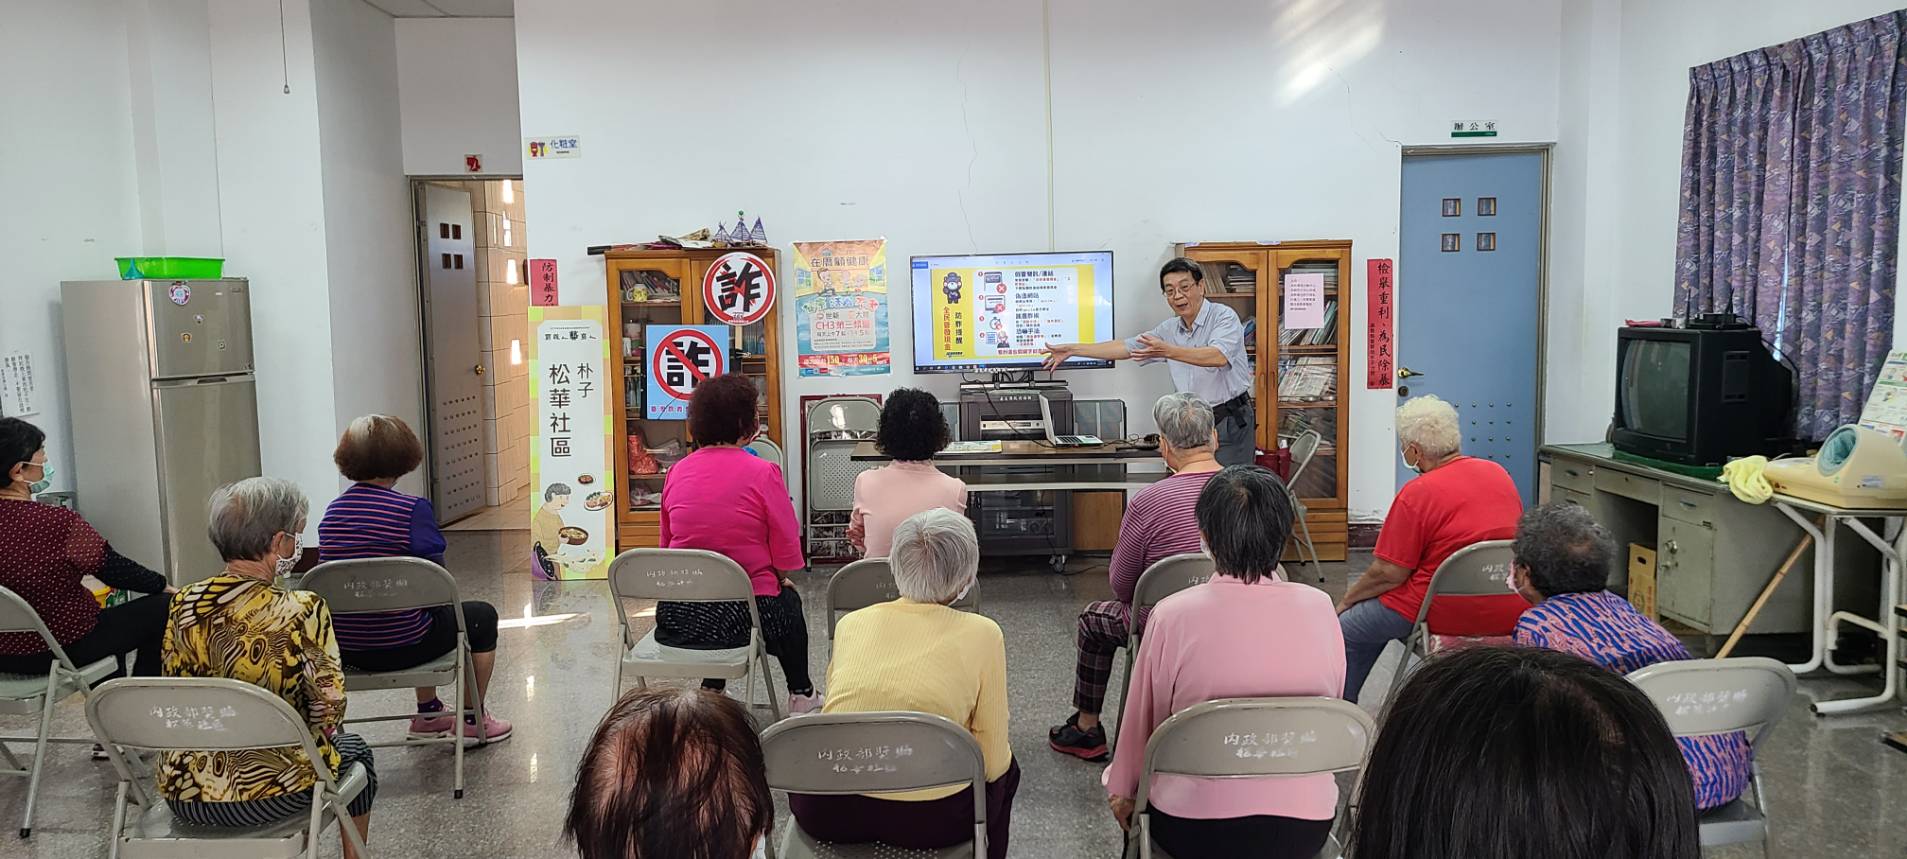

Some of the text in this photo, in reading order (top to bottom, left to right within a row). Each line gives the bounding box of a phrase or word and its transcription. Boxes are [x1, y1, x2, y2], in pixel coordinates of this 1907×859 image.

[542, 262, 556, 306] 防制暴力
[715, 261, 764, 313] 詐
[577, 362, 595, 398] 朴子
[665, 339, 712, 389] 詐
[549, 363, 572, 457] 松華社區
